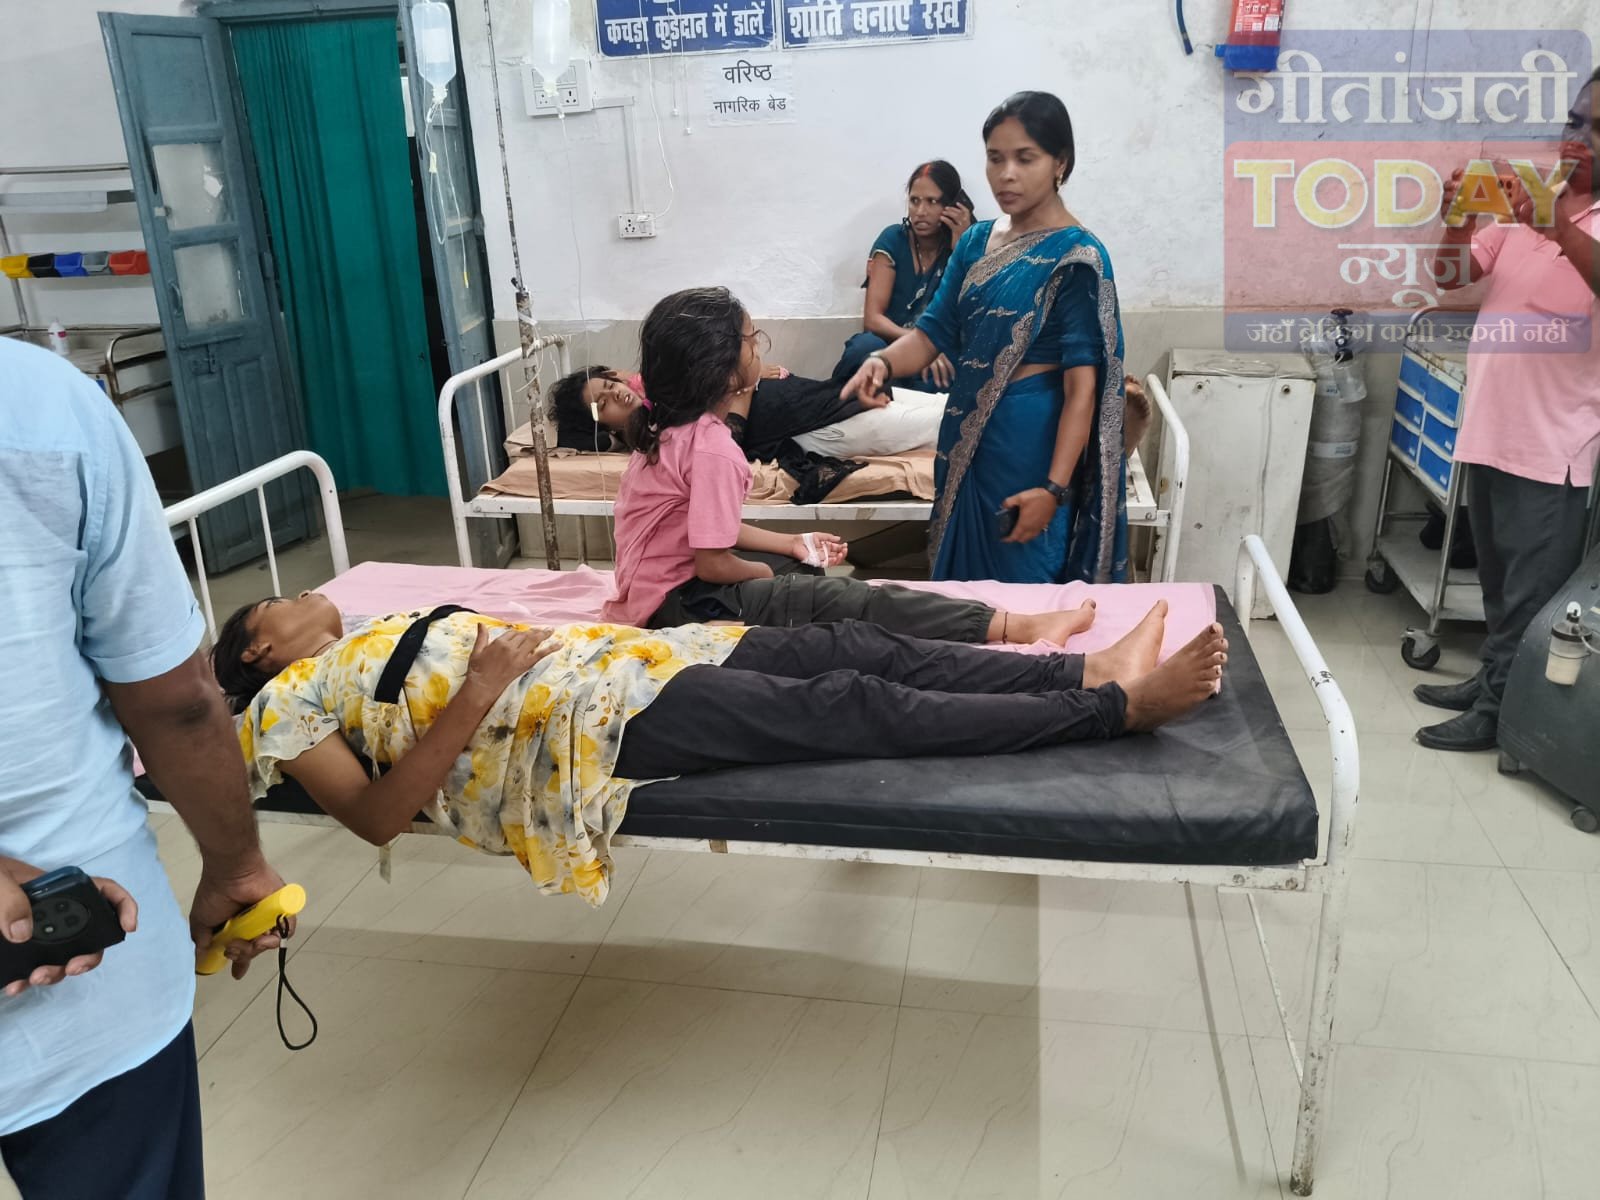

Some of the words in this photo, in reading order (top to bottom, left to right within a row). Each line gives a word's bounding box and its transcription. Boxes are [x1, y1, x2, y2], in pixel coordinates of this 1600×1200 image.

[712, 3, 728, 38] में
[731, 1, 766, 36] डालें
[722, 59, 773, 84] वरिष्ठ
[713, 96, 760, 114] नागरिक
[767, 94, 787, 111] बेड
